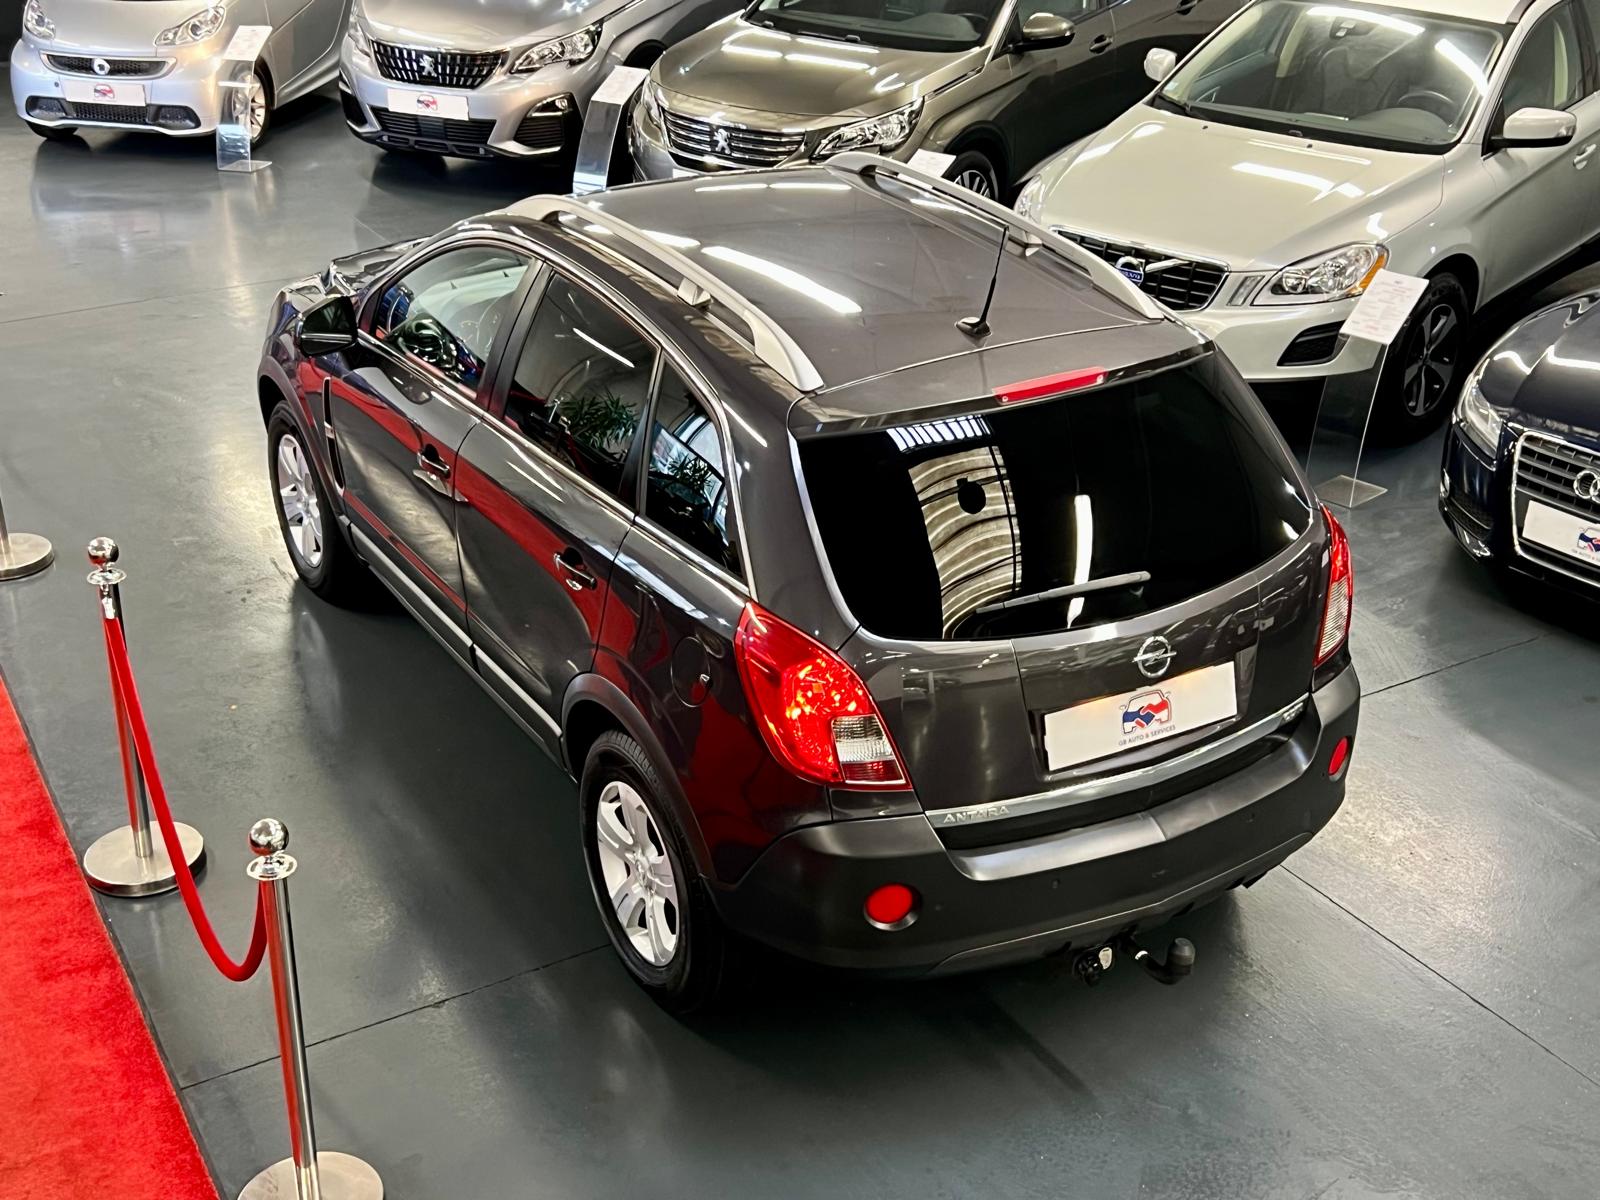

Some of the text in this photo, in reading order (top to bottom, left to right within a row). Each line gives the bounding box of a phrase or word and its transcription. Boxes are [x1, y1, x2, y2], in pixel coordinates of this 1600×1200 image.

[1128, 734, 1145, 743] AUTO
[1151, 724, 1176, 737] SERVICES
[943, 805, 1010, 824] ANTARA
